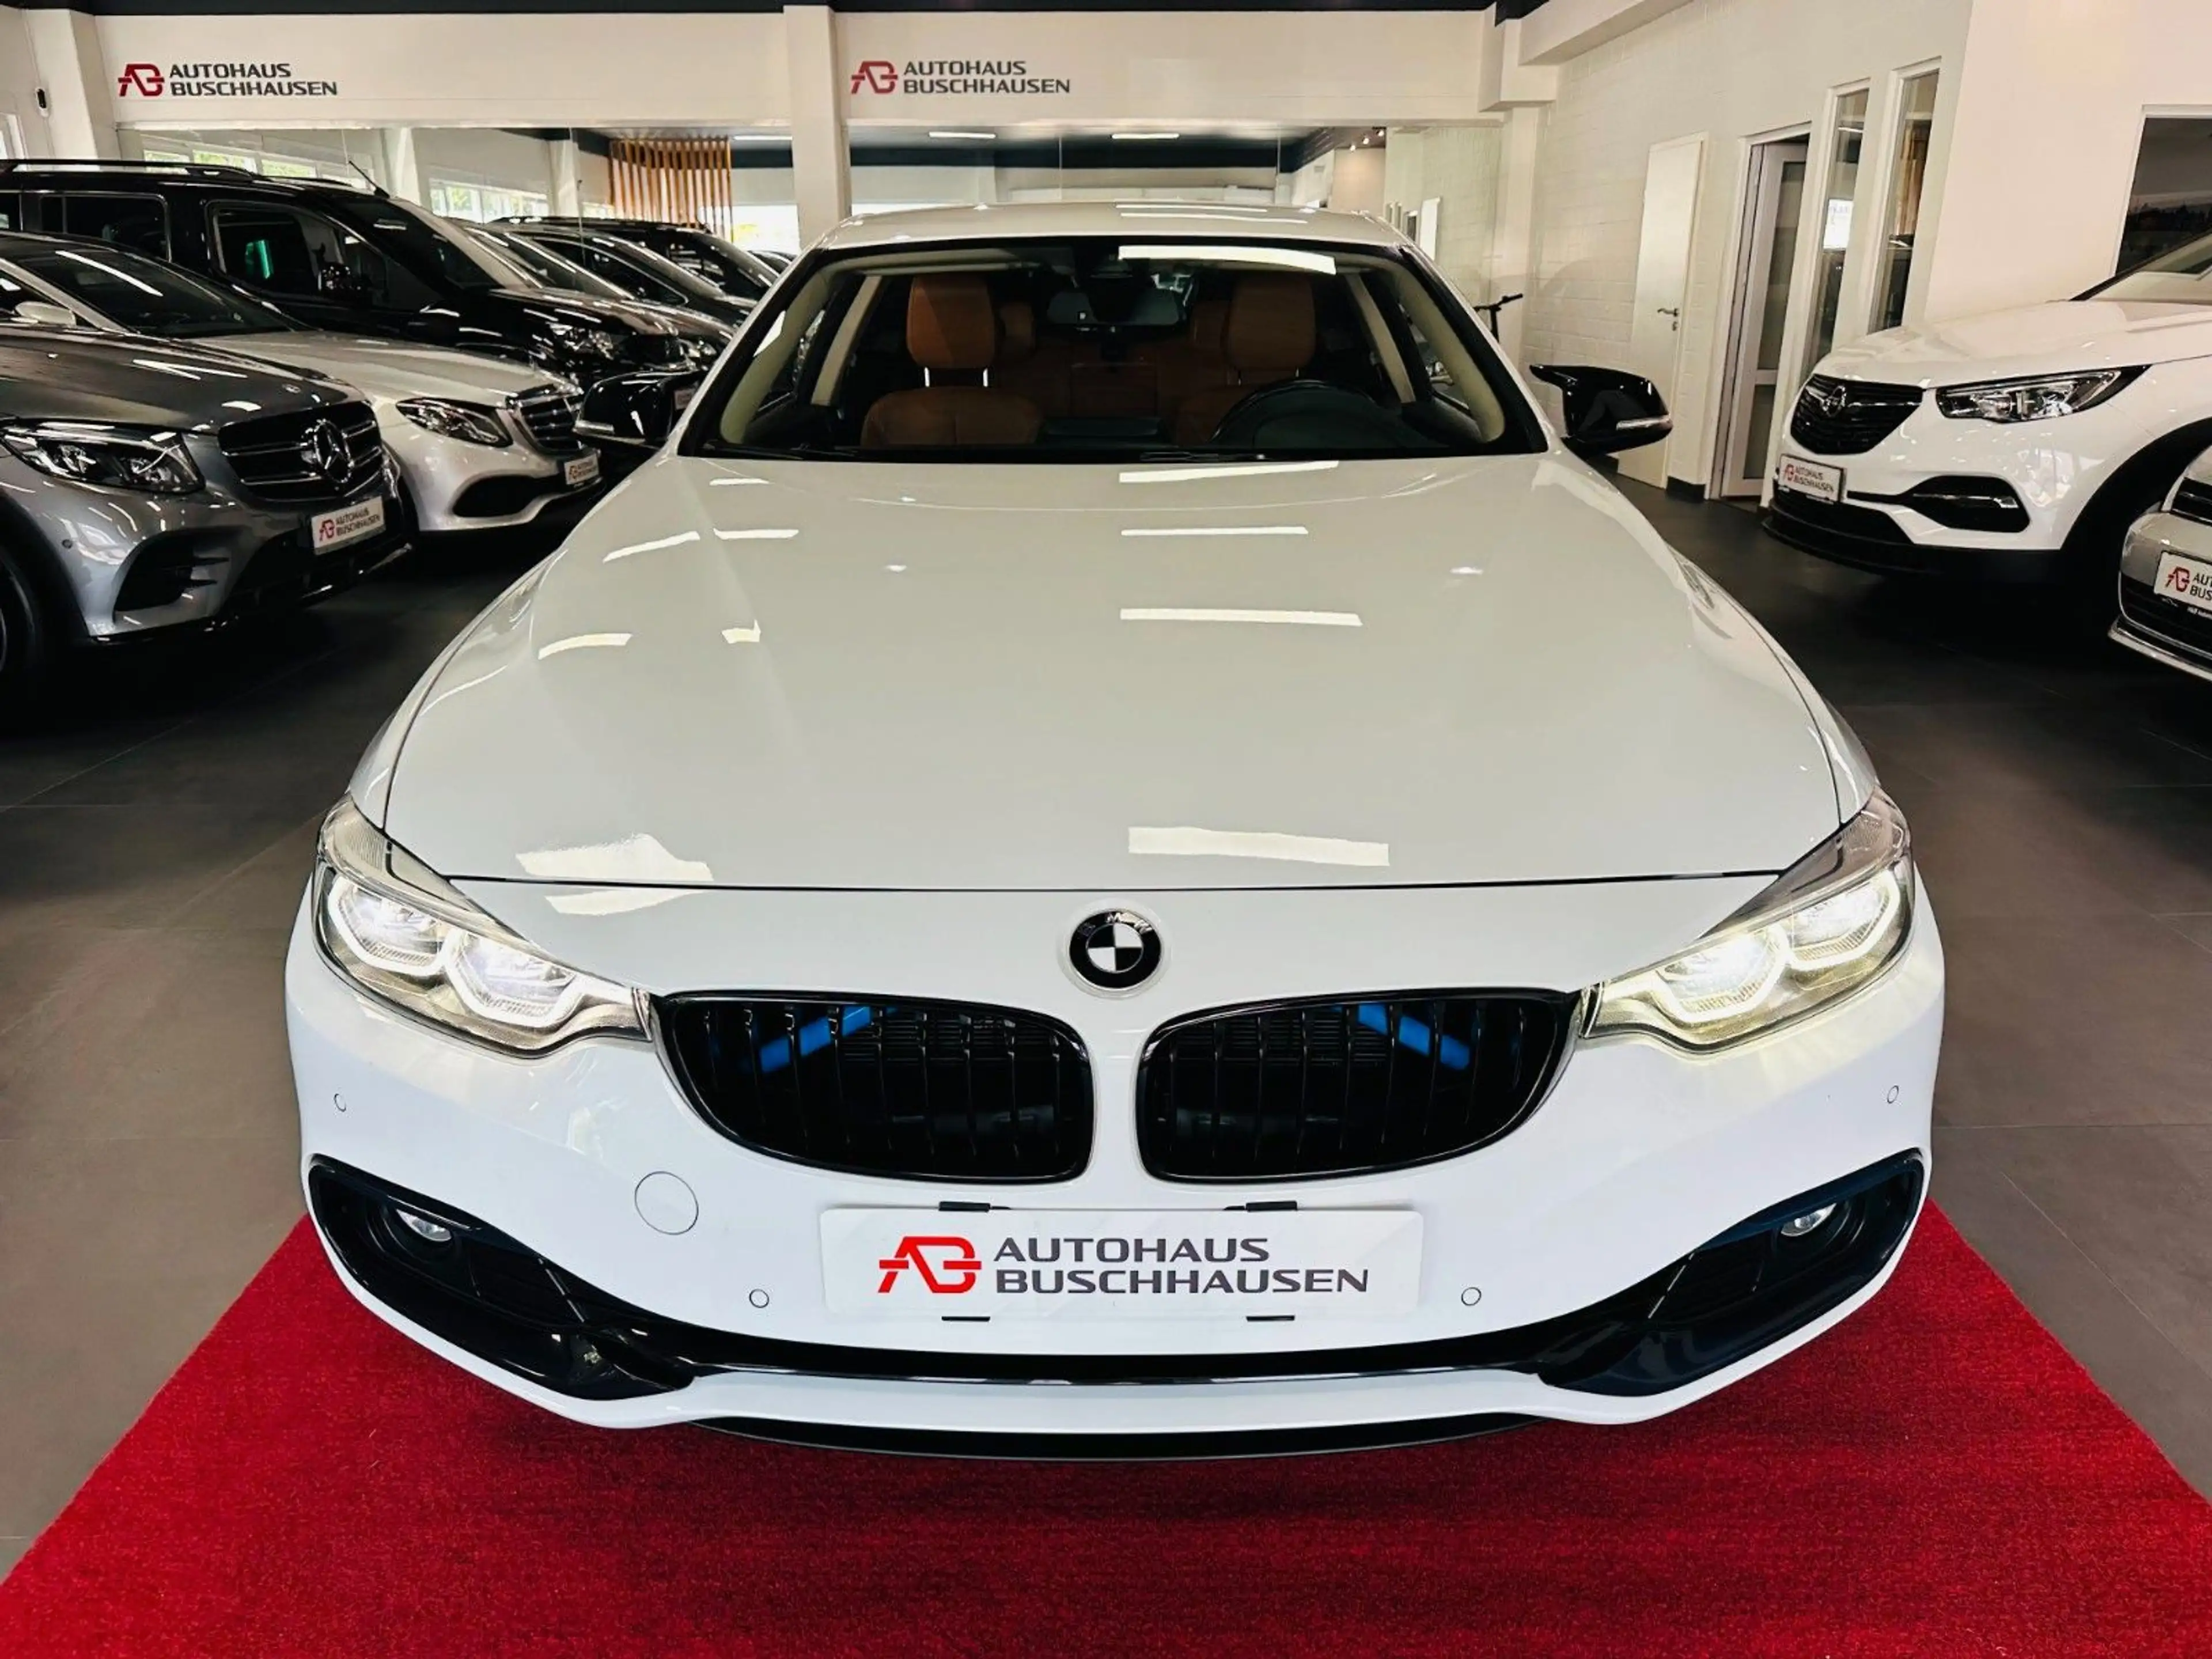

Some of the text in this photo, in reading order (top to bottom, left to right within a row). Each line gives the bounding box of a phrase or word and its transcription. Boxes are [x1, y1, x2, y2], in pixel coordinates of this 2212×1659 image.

[170, 63, 291, 78] AUTOHAUS
[904, 60, 1027, 75] AUTOHAUS
[171, 81, 338, 96] BUSCHHAUSEN
[904, 79, 1070, 94] BUSCHHAUSEN
[994, 1237, 1269, 1263] AUTOHAUS
[997, 1269, 1368, 1294] BUSCHHAUSEN
